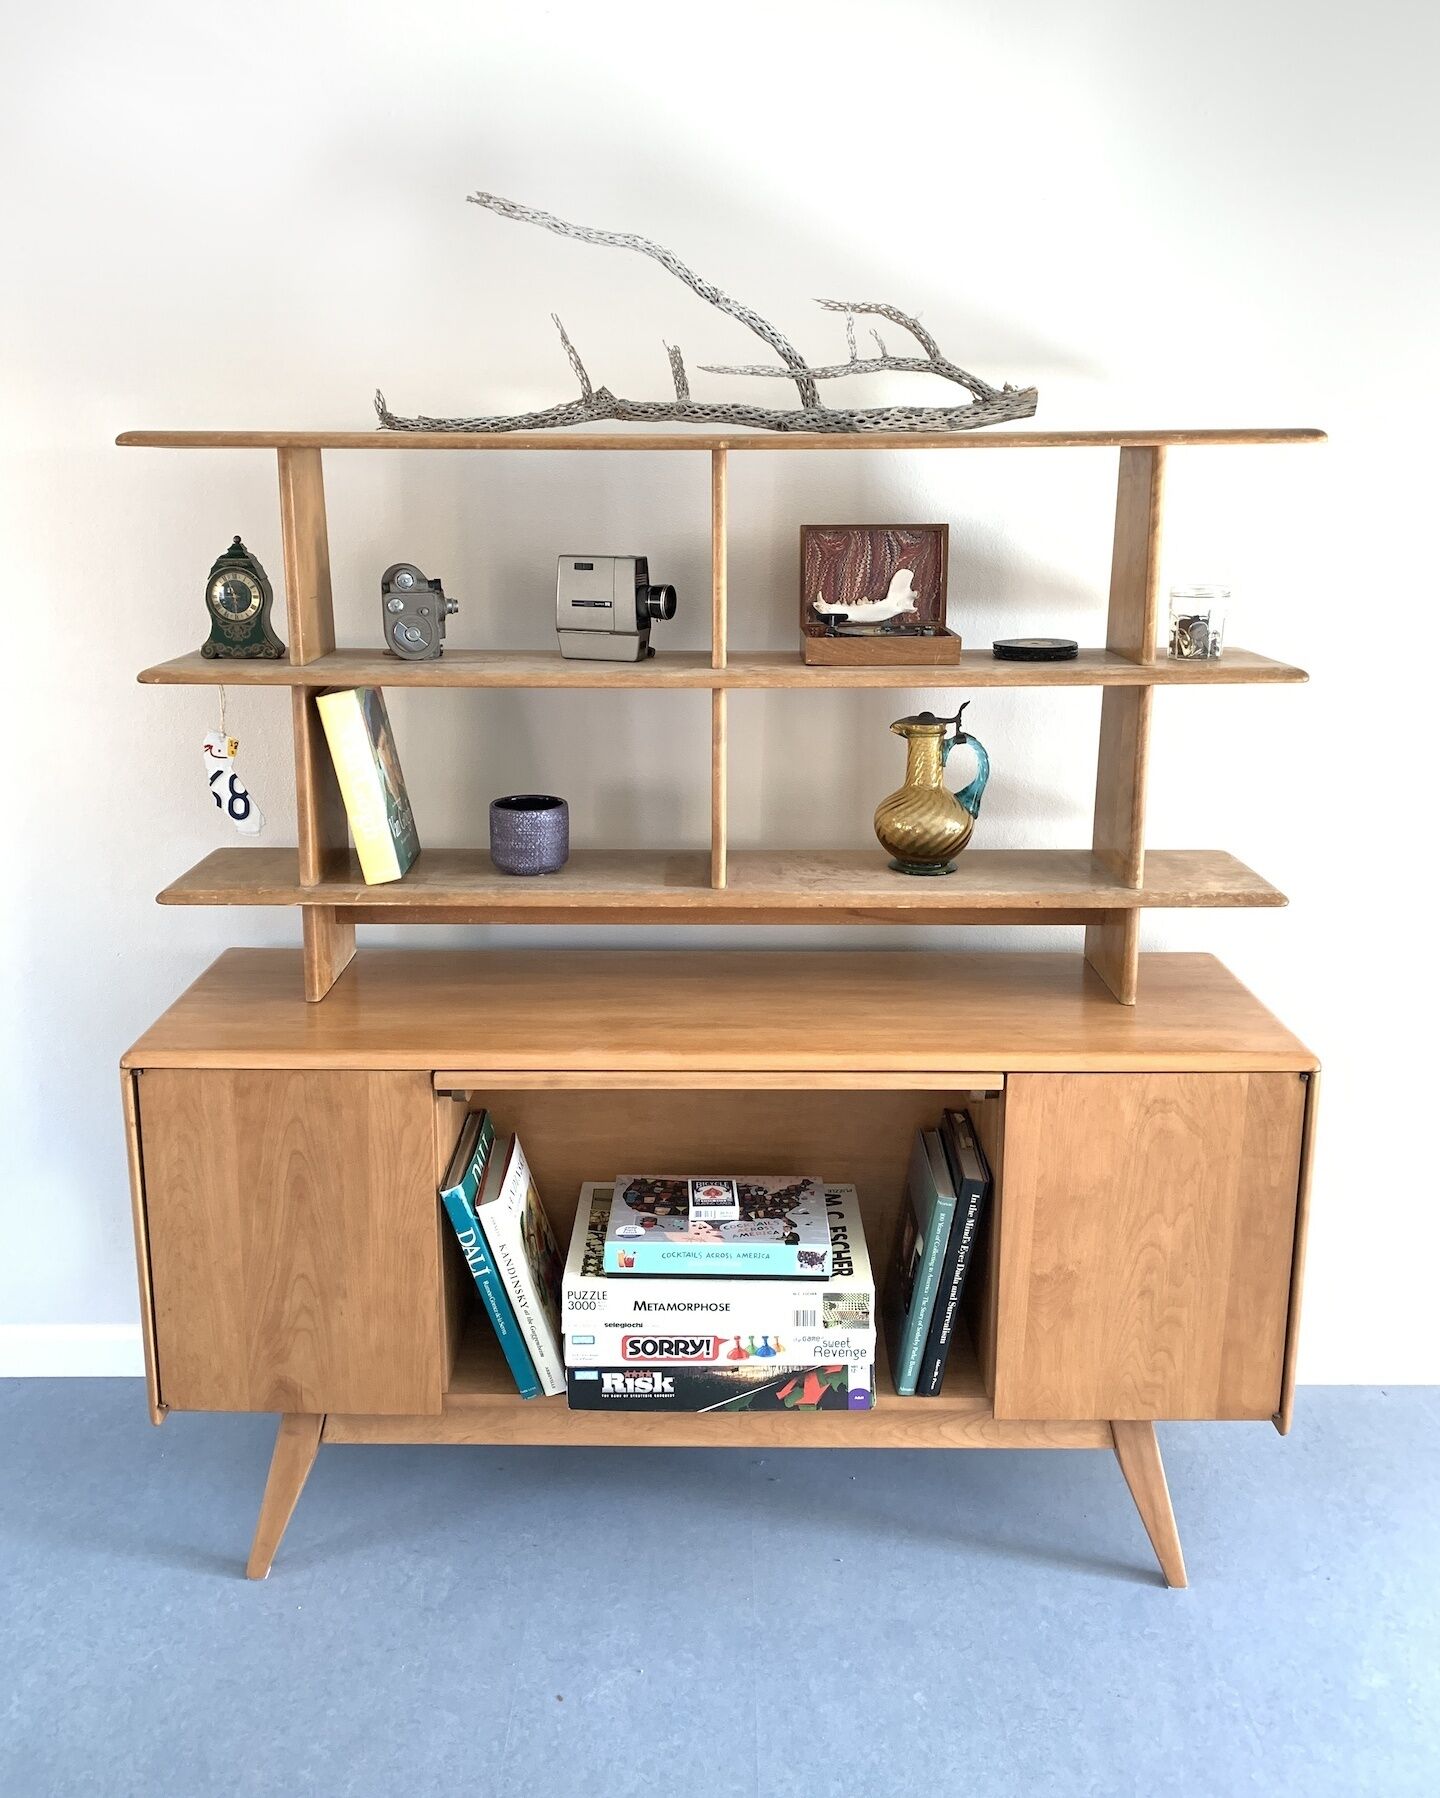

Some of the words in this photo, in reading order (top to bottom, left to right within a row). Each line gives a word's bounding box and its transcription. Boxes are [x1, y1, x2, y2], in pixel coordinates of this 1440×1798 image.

[969, 1193, 980, 1203] In
[967, 1204, 977, 1217] the
[661, 1251, 703, 1259] COCKTAILS
[830, 1225, 854, 1277] ESCHER
[927, 1241, 940, 1267] Collecting
[498, 1243, 528, 1309] KANDINSKY
[952, 1263, 965, 1284] Dada
[567, 1291, 607, 1300] PUZZLE
[948, 1285, 959, 1300] and
[568, 1301, 596, 1310] 3000
[633, 1301, 730, 1311] METAMORPHOSE
[526, 1315, 534, 1324] the
[939, 1301, 956, 1344] Surrealism
[527, 1324, 546, 1358] Guggenheim
[628, 1339, 711, 1356] SORRY!
[823, 1337, 851, 1348] sweet
[813, 1346, 867, 1360] Revenge
